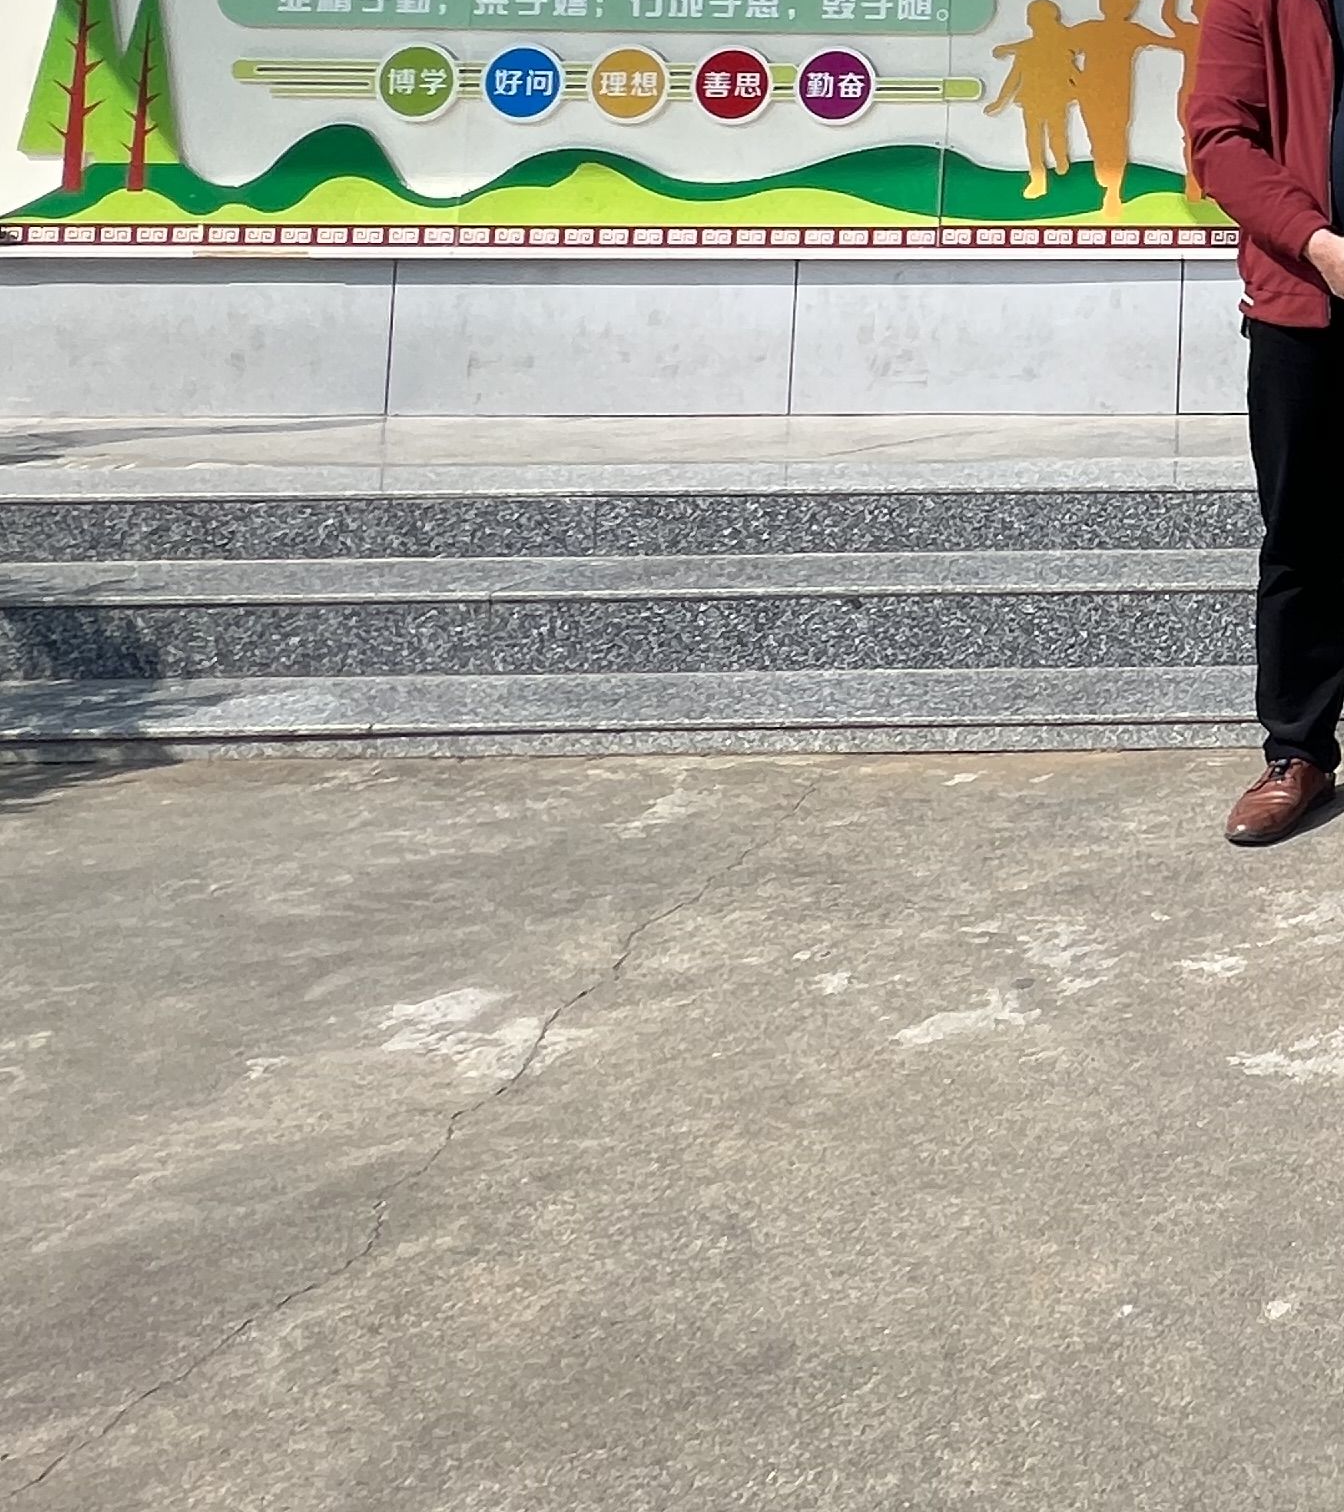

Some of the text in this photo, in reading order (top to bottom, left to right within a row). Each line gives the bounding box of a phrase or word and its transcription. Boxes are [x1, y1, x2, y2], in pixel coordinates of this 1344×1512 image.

[386, 66, 448, 95] 博学
[494, 68, 554, 96] 好问
[599, 70, 659, 98] 理想
[703, 72, 762, 99] 善思
[806, 72, 866, 99] 勤奋
